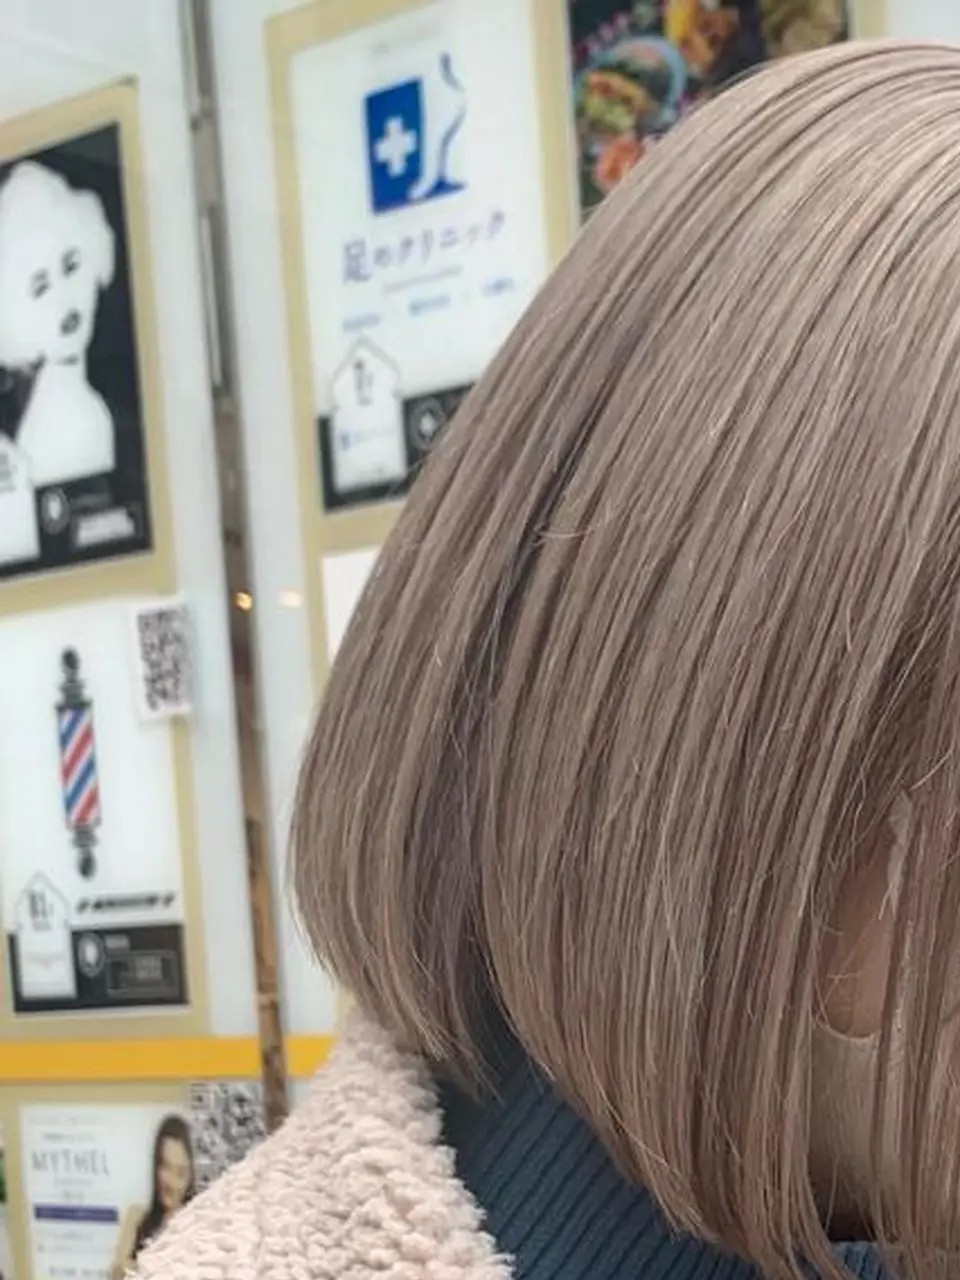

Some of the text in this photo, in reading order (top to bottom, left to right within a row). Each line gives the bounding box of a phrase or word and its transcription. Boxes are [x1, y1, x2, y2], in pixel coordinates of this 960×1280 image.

[342, 210, 507, 284] 足のクリニック
